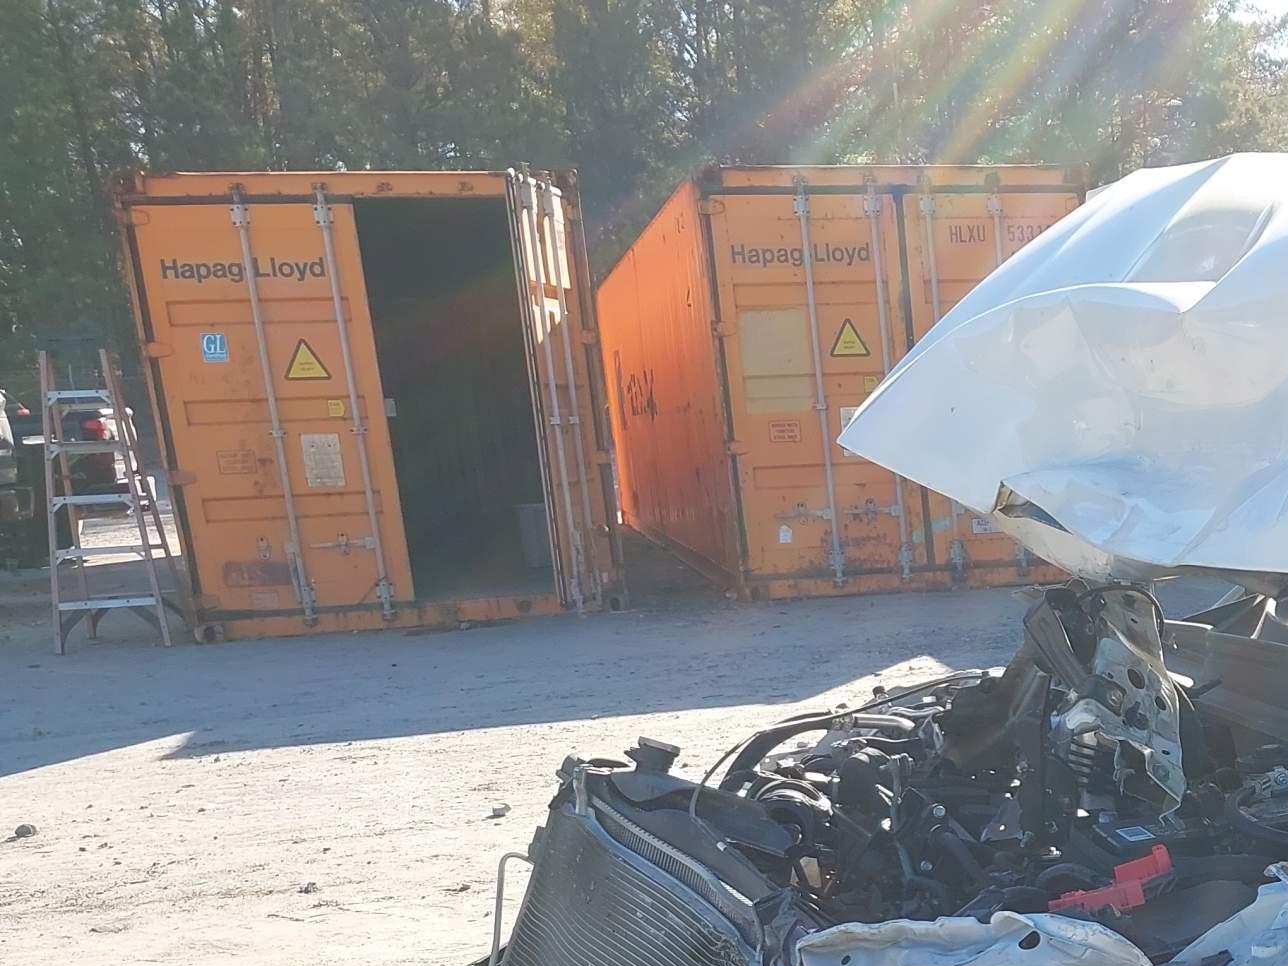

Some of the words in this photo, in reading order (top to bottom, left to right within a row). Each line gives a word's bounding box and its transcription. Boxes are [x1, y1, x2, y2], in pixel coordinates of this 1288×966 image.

[949, 224, 986, 244] HLXU
[1006, 224, 1053, 243] 533
[203, 334, 226, 354] GL
